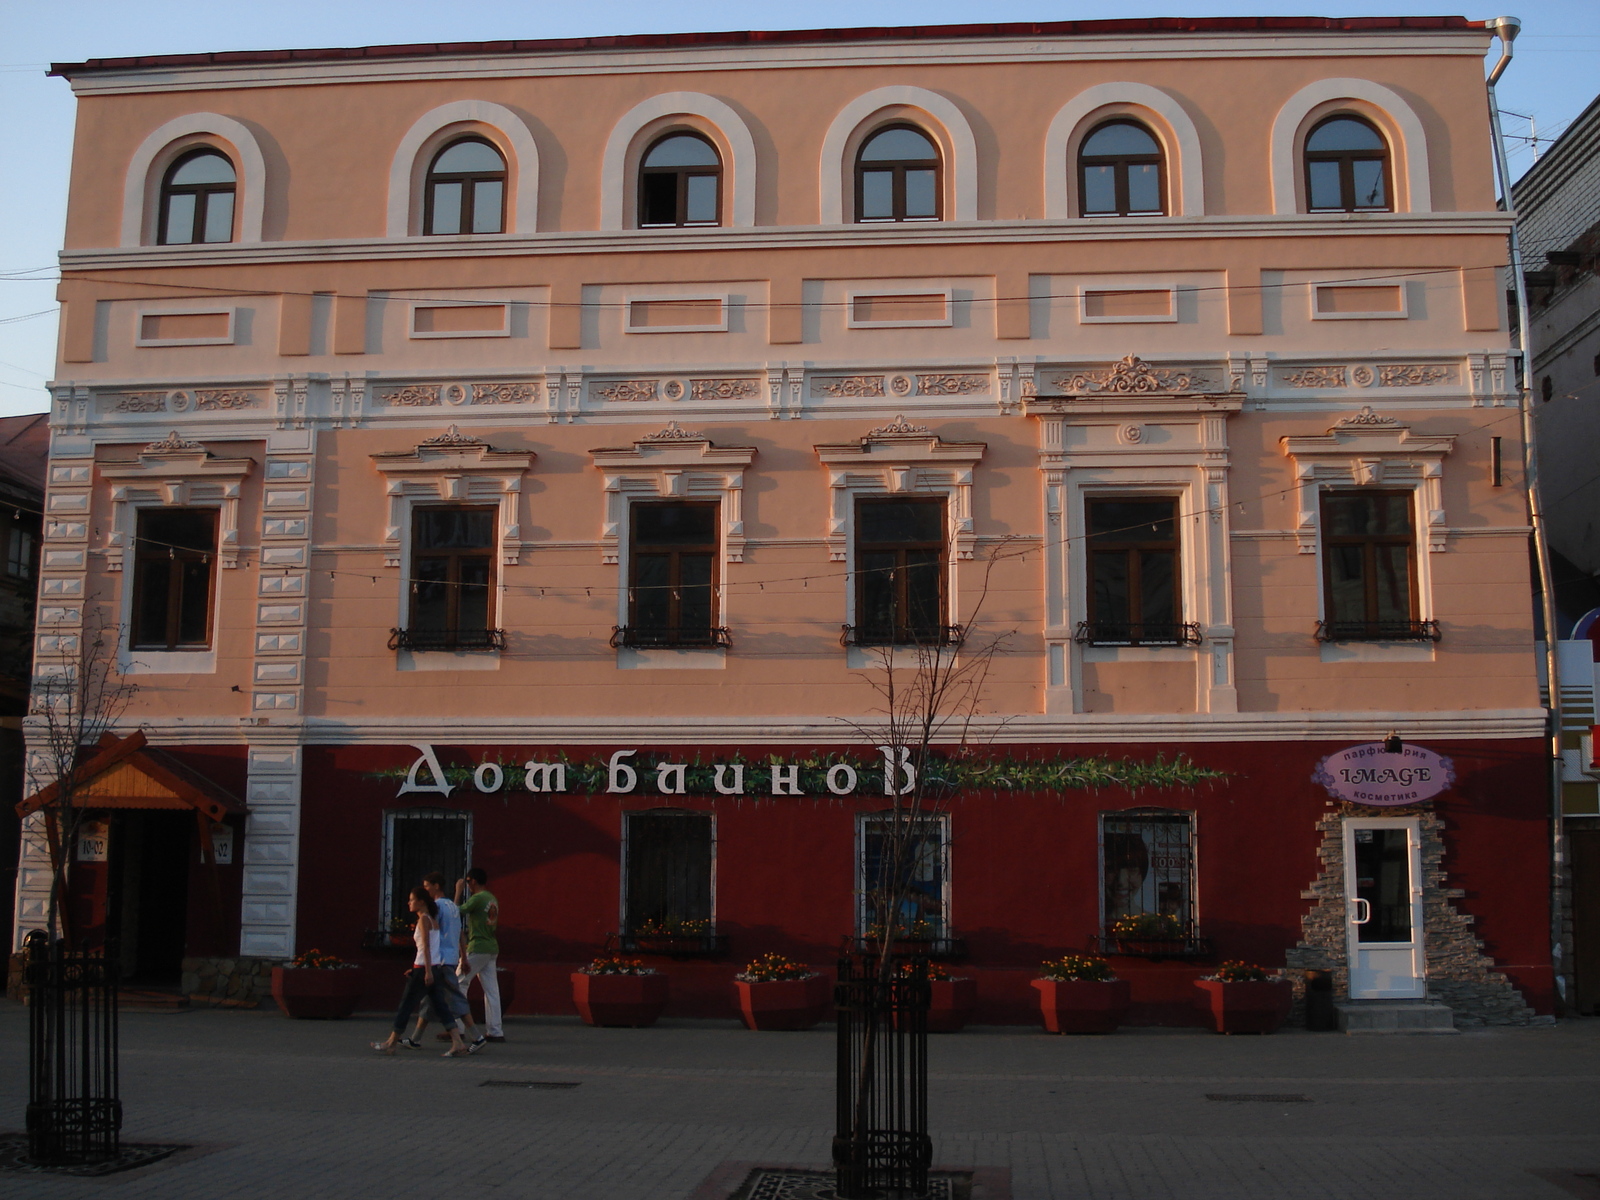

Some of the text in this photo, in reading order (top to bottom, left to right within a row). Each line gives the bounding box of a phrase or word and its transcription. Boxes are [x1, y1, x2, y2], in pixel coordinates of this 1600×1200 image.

[1343, 745, 1427, 761] парфюрия
[396, 744, 567, 798] Дом
[1340, 767, 1432, 787] IMAGE
[1353, 789, 1418, 801] косметика
